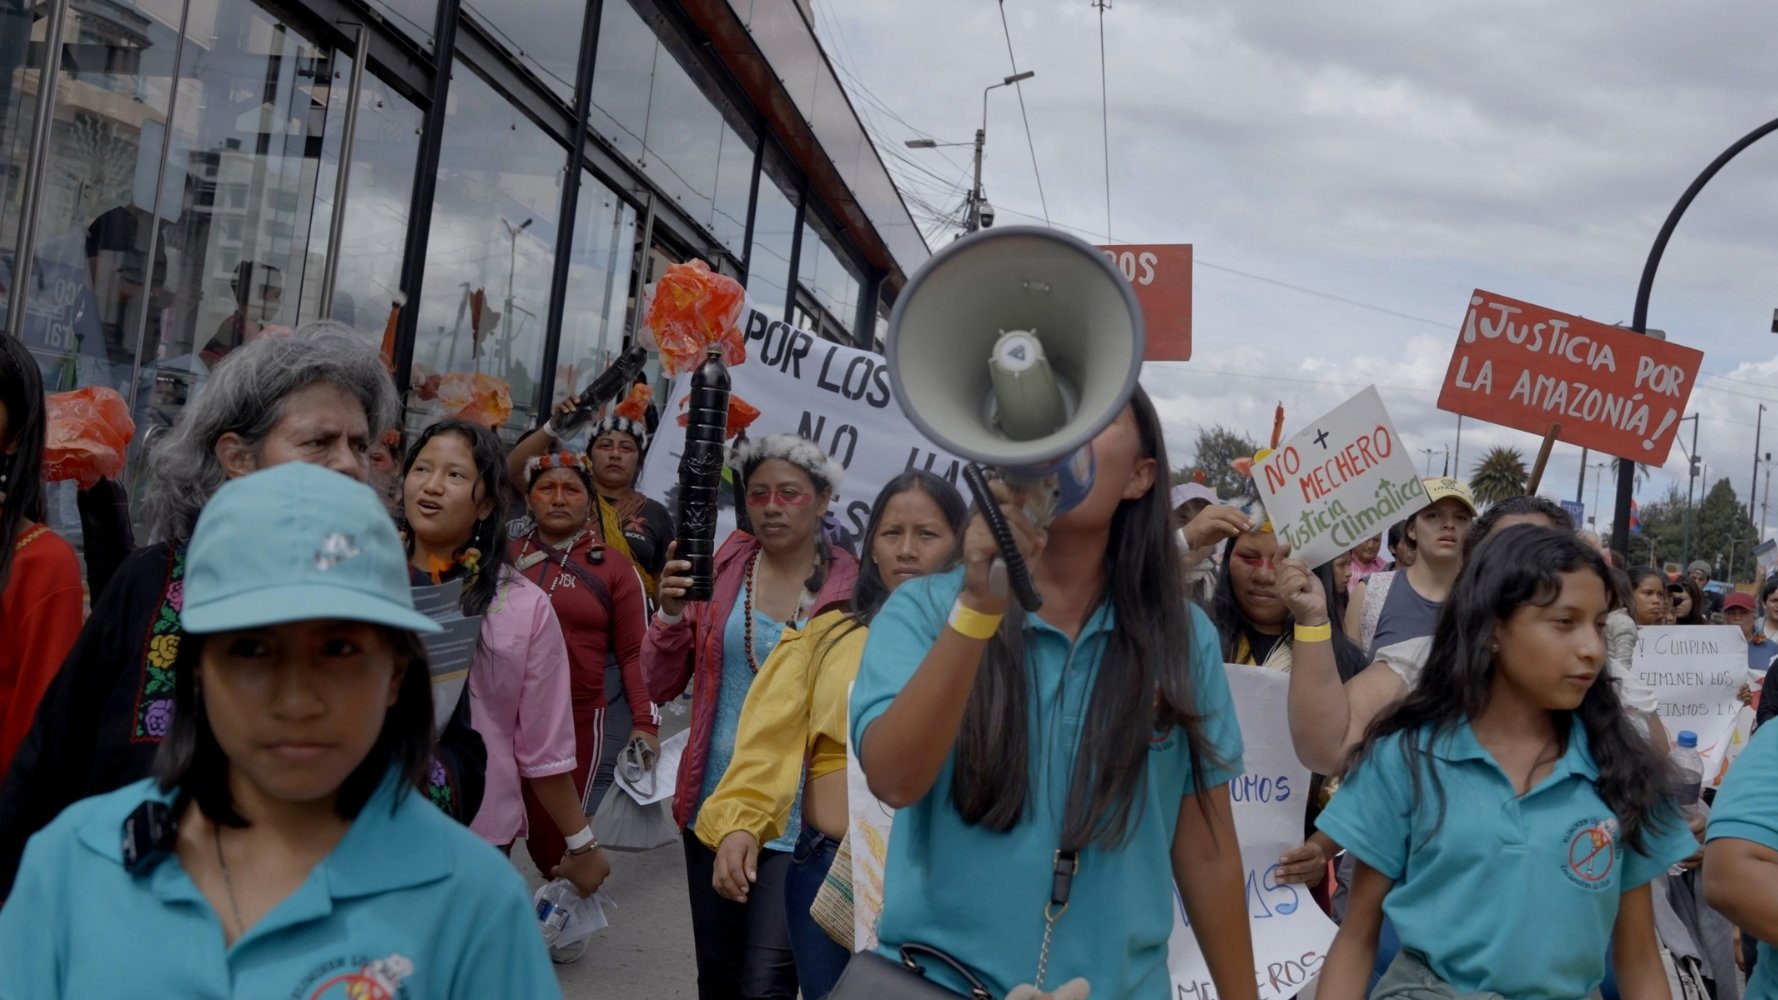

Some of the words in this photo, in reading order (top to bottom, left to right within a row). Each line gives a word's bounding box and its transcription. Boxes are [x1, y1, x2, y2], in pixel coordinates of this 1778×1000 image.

[744, 309, 813, 379] POR
[817, 346, 890, 408] LOS
[1635, 356, 1684, 398] POR
[1455, 356, 1493, 395] LA
[1509, 369, 1677, 450] AMAZONÍA!
[798, 411, 858, 472] NO
[1299, 425, 1391, 504] MECHERO
[1264, 446, 1299, 494] NO
[1279, 499, 1347, 551] Justicia
[1711, 670, 1734, 686] LOS
[1656, 703, 1710, 717] ETAMOS
[1231, 774, 1291, 803] OMOS
